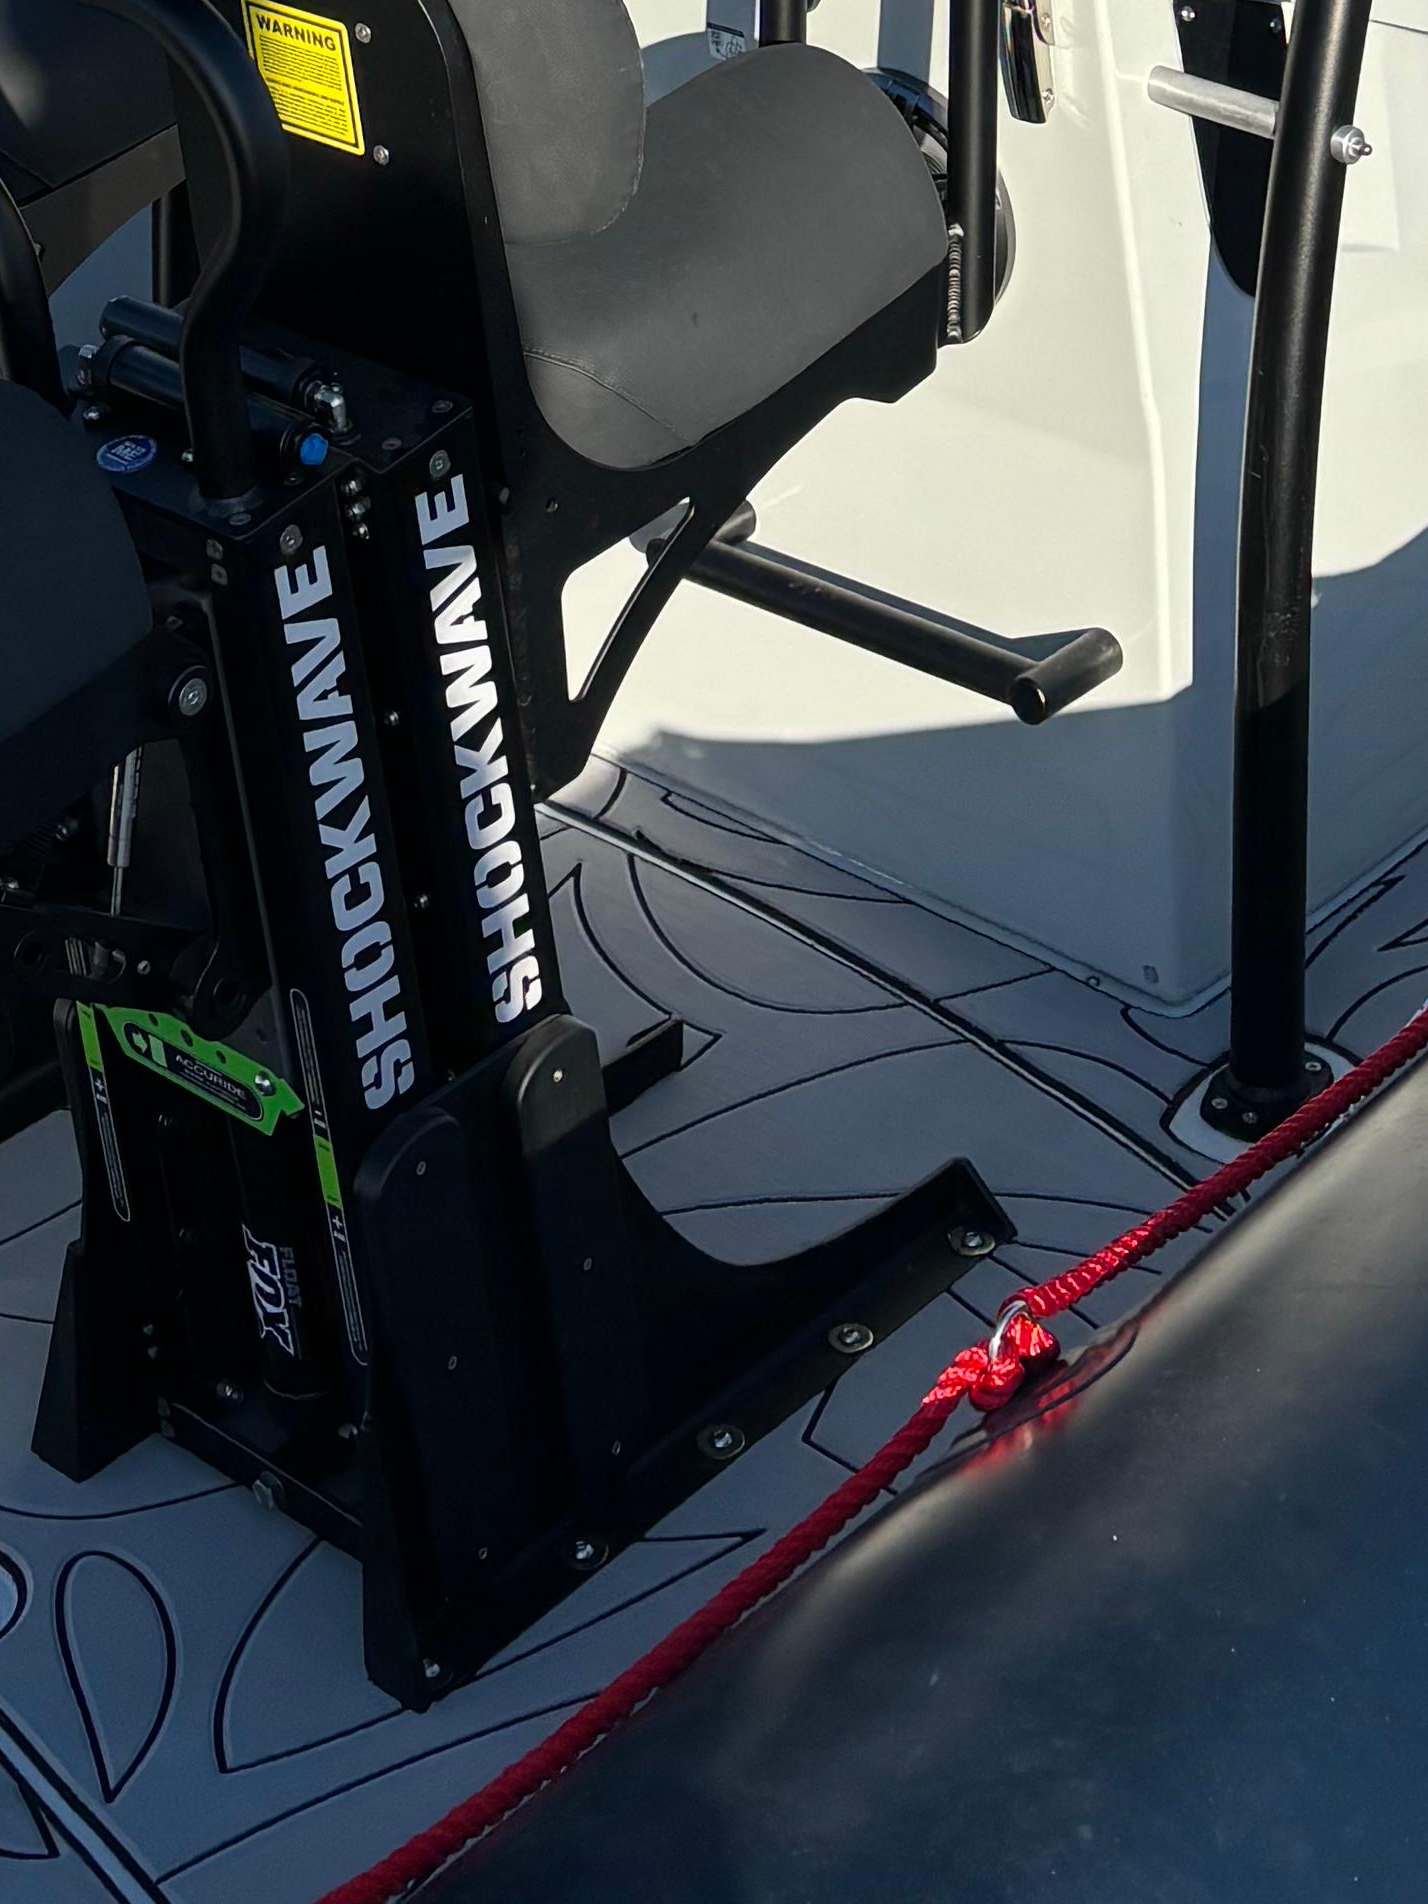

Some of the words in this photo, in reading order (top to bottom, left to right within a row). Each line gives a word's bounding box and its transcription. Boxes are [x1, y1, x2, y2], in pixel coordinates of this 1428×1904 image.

[256, 14, 337, 52] WARNING
[273, 544, 415, 1110] SHOCKWAVE
[414, 473, 543, 1024] SHOCKWAVE
[176, 1054, 248, 1100] ACCURIDE
